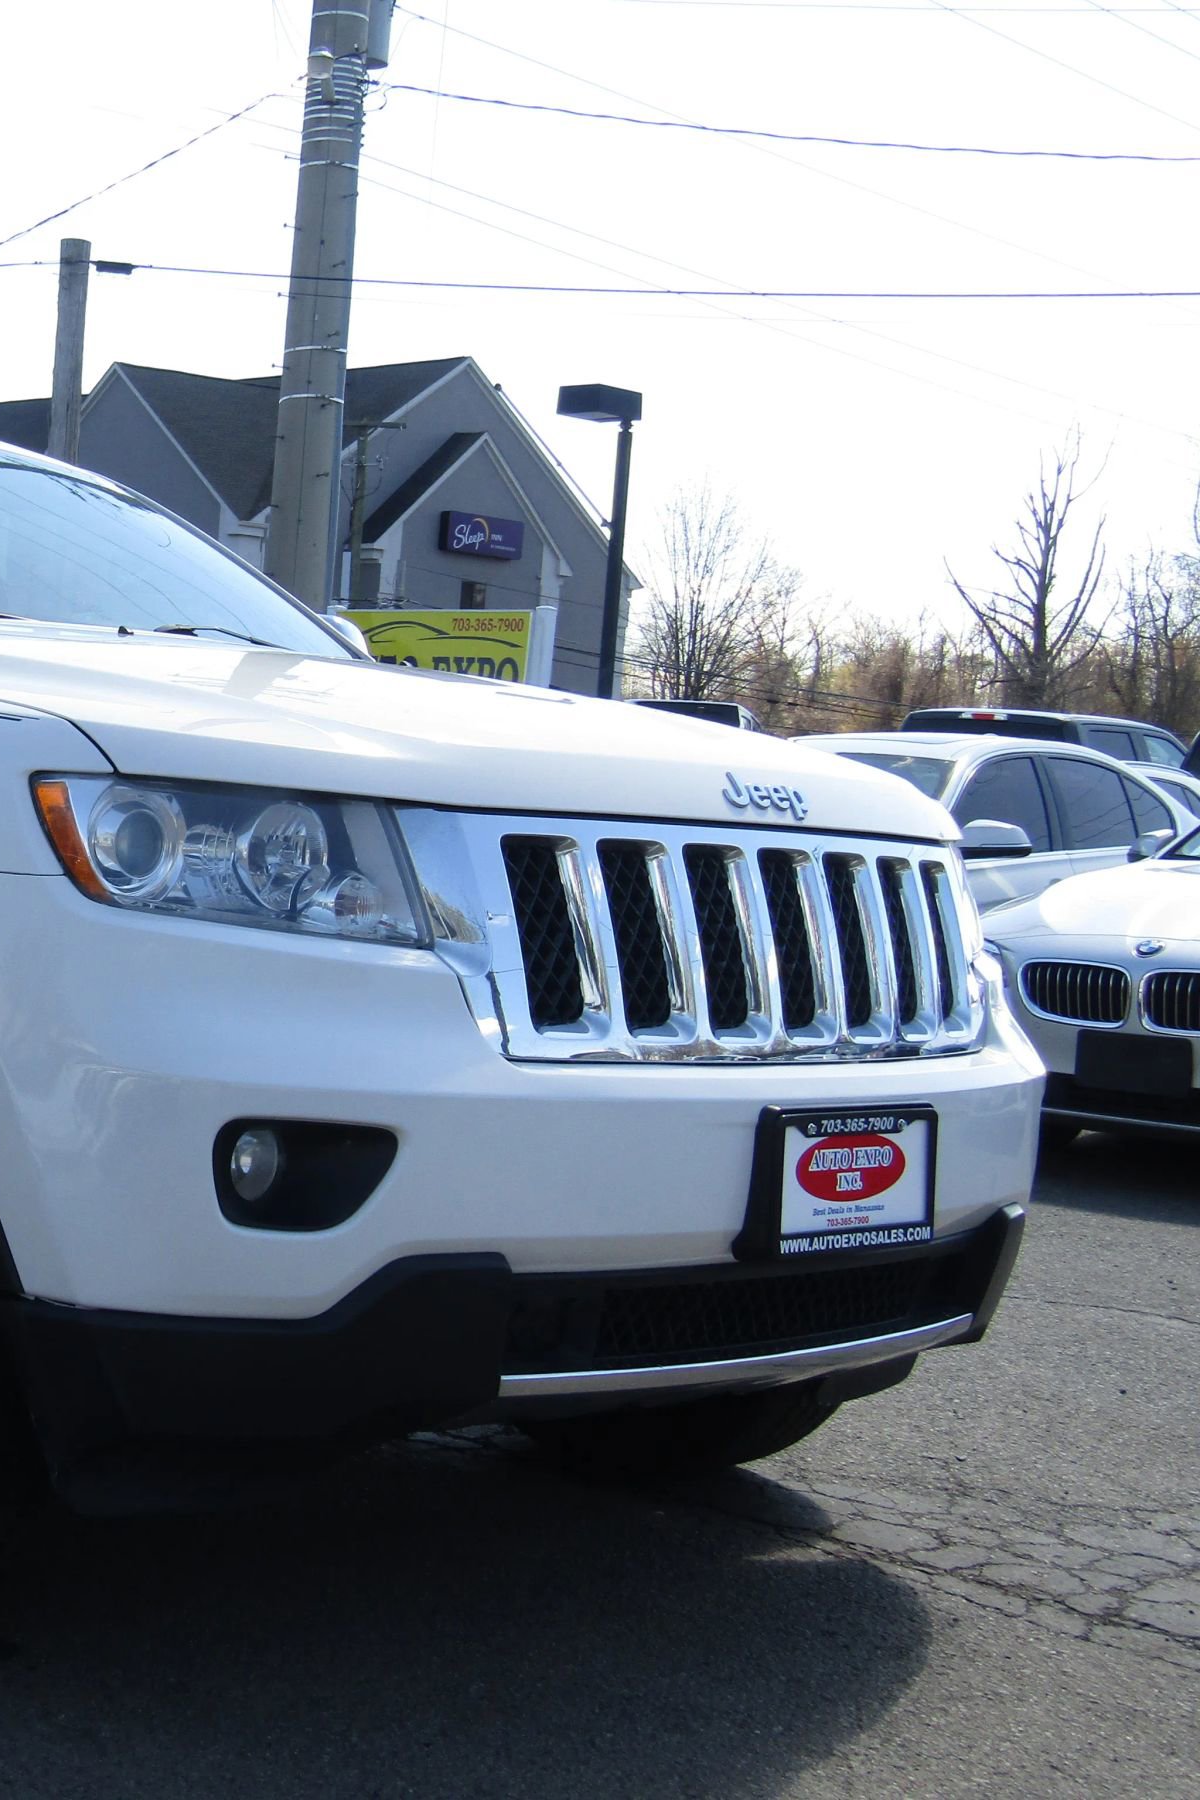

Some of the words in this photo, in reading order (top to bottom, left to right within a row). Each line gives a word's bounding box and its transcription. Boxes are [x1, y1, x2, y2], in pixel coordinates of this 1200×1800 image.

[453, 524, 485, 550] Sleep
[451, 617, 525, 632] 703-365-7900
[722, 771, 808, 821] Jeep
[820, 1117, 894, 1133] 703-365-7900
[809, 1149, 851, 1171] AUTO
[852, 1146, 893, 1168] EXPO
[836, 1172, 863, 1192] INC.
[812, 1208, 825, 1216] Best
[828, 1207, 844, 1215] Deals
[826, 1215, 870, 1227] 703-365-7900
[780, 1226, 931, 1254] WWW.AUTOEXPOSALES.COM
